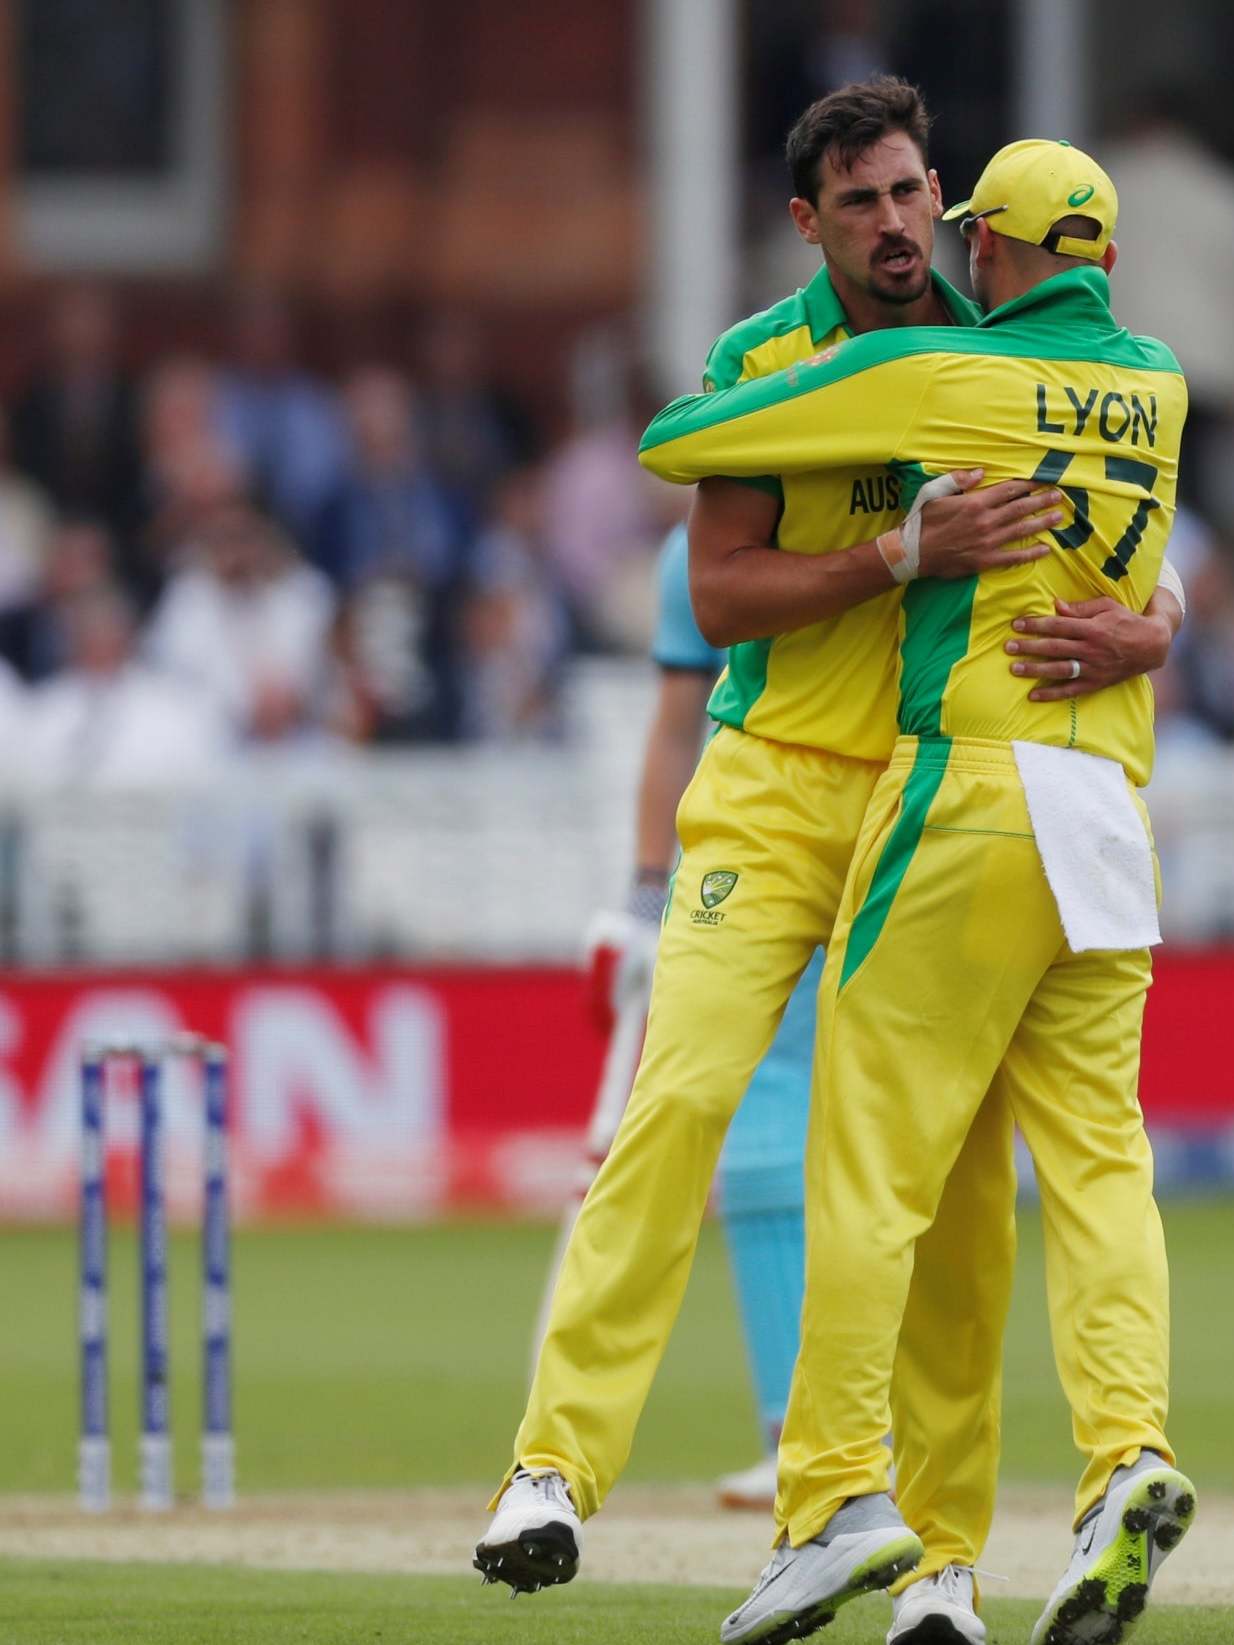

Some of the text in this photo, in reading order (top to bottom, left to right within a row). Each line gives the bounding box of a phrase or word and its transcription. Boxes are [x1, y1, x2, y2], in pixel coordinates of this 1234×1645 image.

[1036, 383, 1157, 447] LYON
[1030, 448, 1159, 581] 67
[690, 910, 727, 921] CRICKET
[0, 984, 447, 1216] AN
